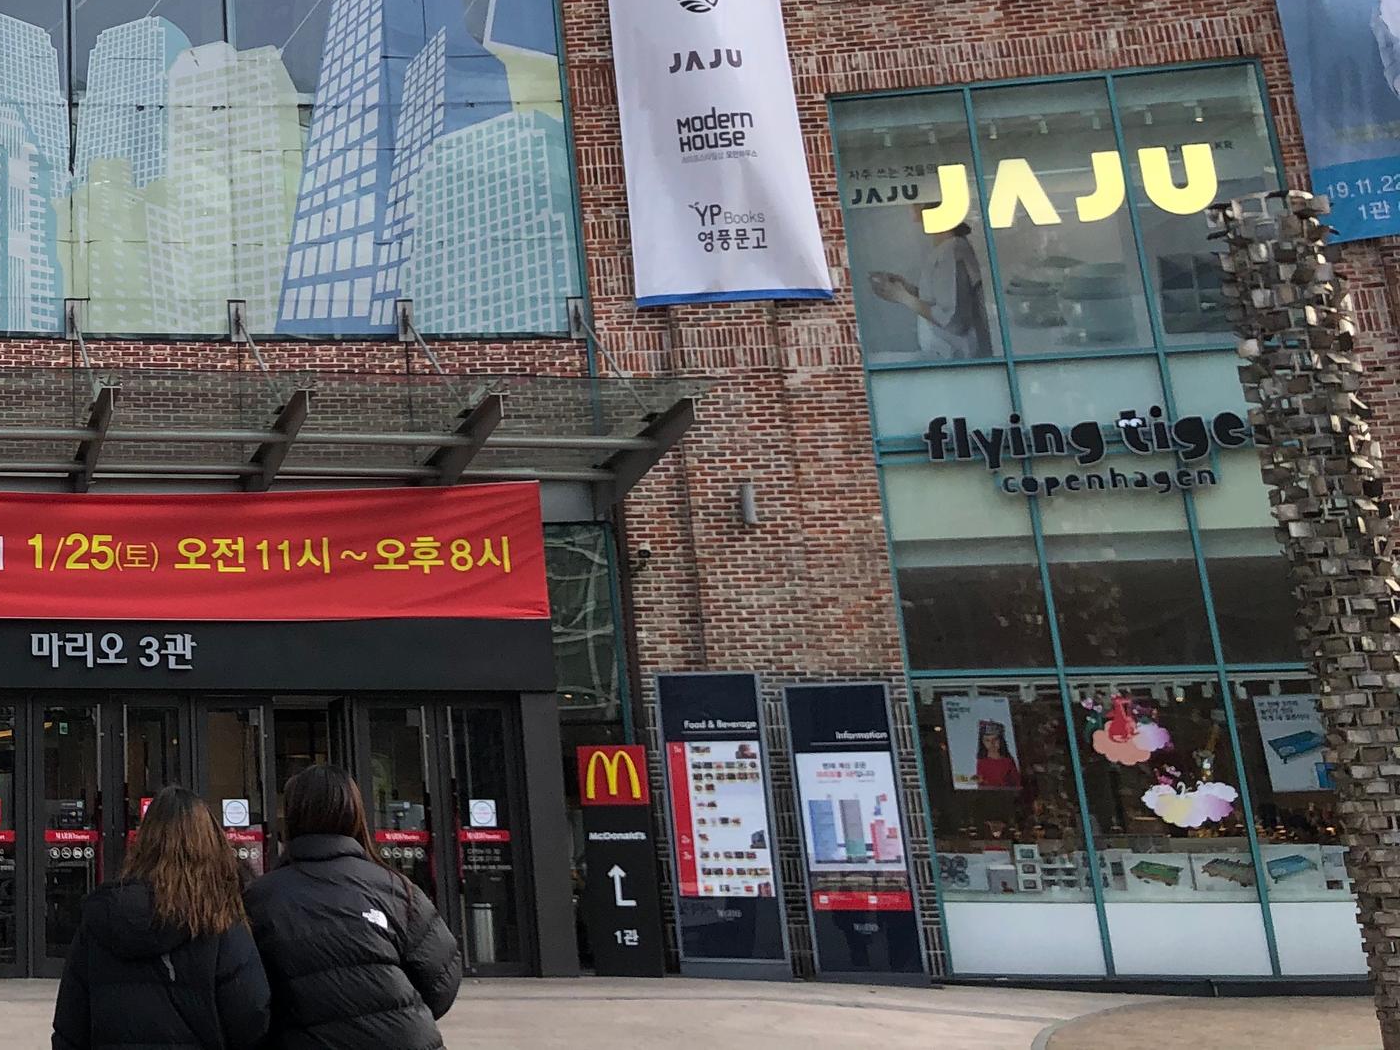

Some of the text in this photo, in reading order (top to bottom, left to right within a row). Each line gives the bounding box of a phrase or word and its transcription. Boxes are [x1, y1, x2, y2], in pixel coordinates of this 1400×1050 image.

[669, 48, 743, 74] JAJU
[852, 184, 918, 205] JAJU
[921, 143, 1218, 234] JAJU
[689, 202, 765, 226] YP Books
[1358, 200, 1390, 220] 1관
[698, 227, 768, 252] 영풍문고
[923, 413, 1106, 470] flying
[1002, 467, 1218, 498] copenhagen
[27, 533, 159, 572] 1/25(토)
[174, 536, 247, 573] 오전
[31, 631, 197, 670] 마리오 3관
[683, 720, 706, 730] Food
[835, 730, 888, 741] Information
[589, 830, 646, 842] McDonald's
[614, 928, 639, 946] 1관
